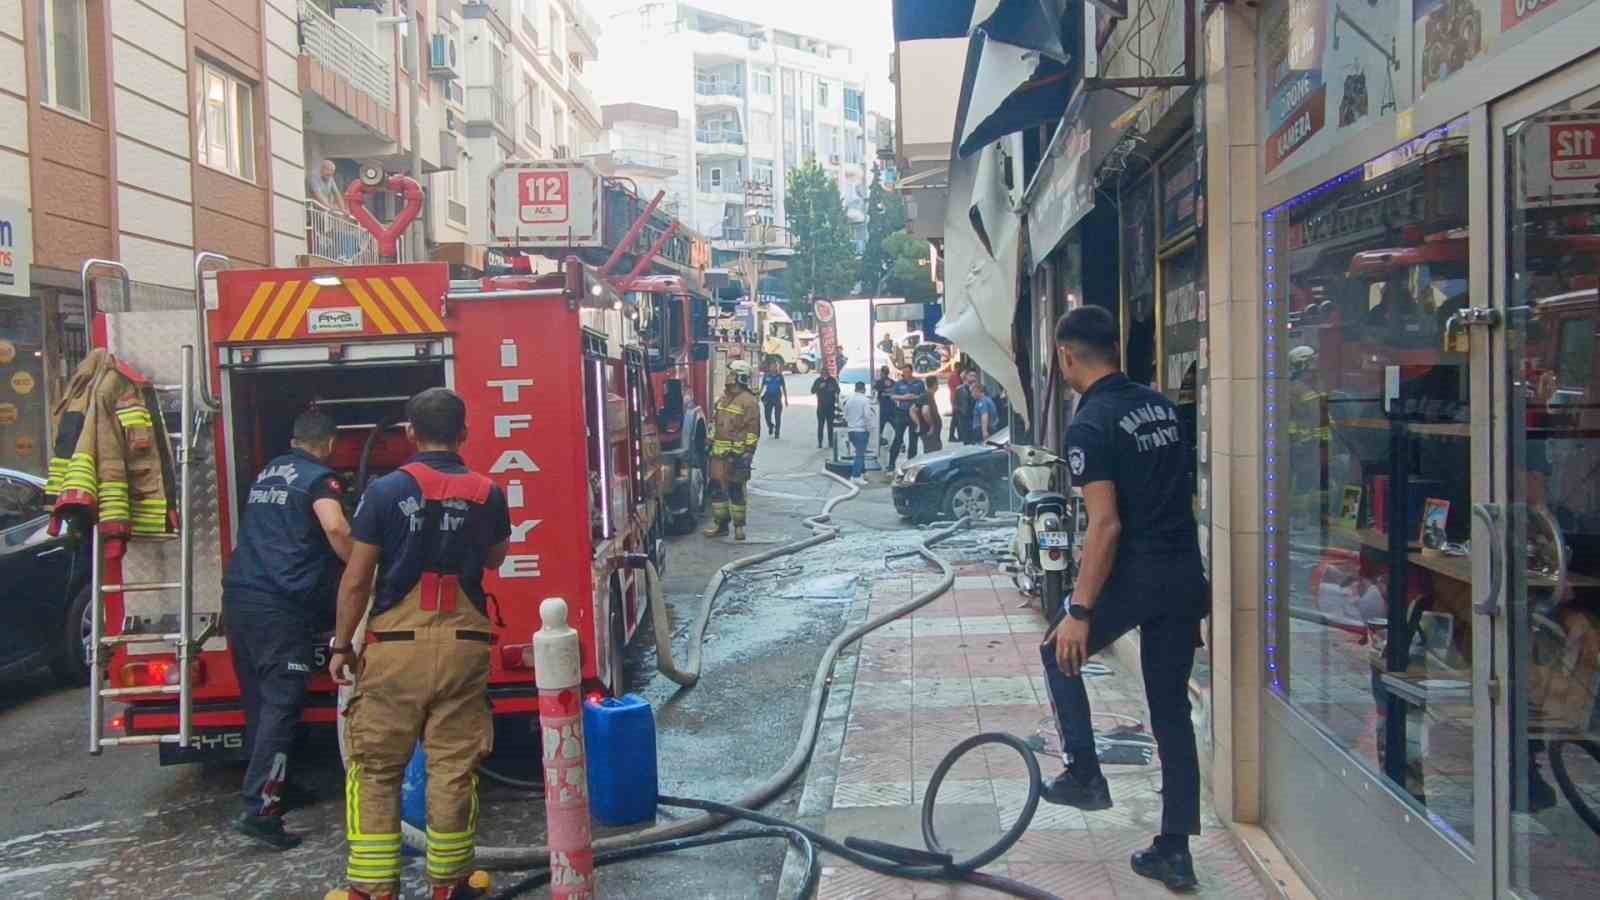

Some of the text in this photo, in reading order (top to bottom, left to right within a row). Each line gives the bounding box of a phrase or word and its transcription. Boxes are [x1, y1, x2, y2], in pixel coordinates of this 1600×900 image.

[526, 176, 561, 201] 112
[1119, 402, 1178, 434] MANİSA
[488, 339, 543, 577] İTFAİYE
